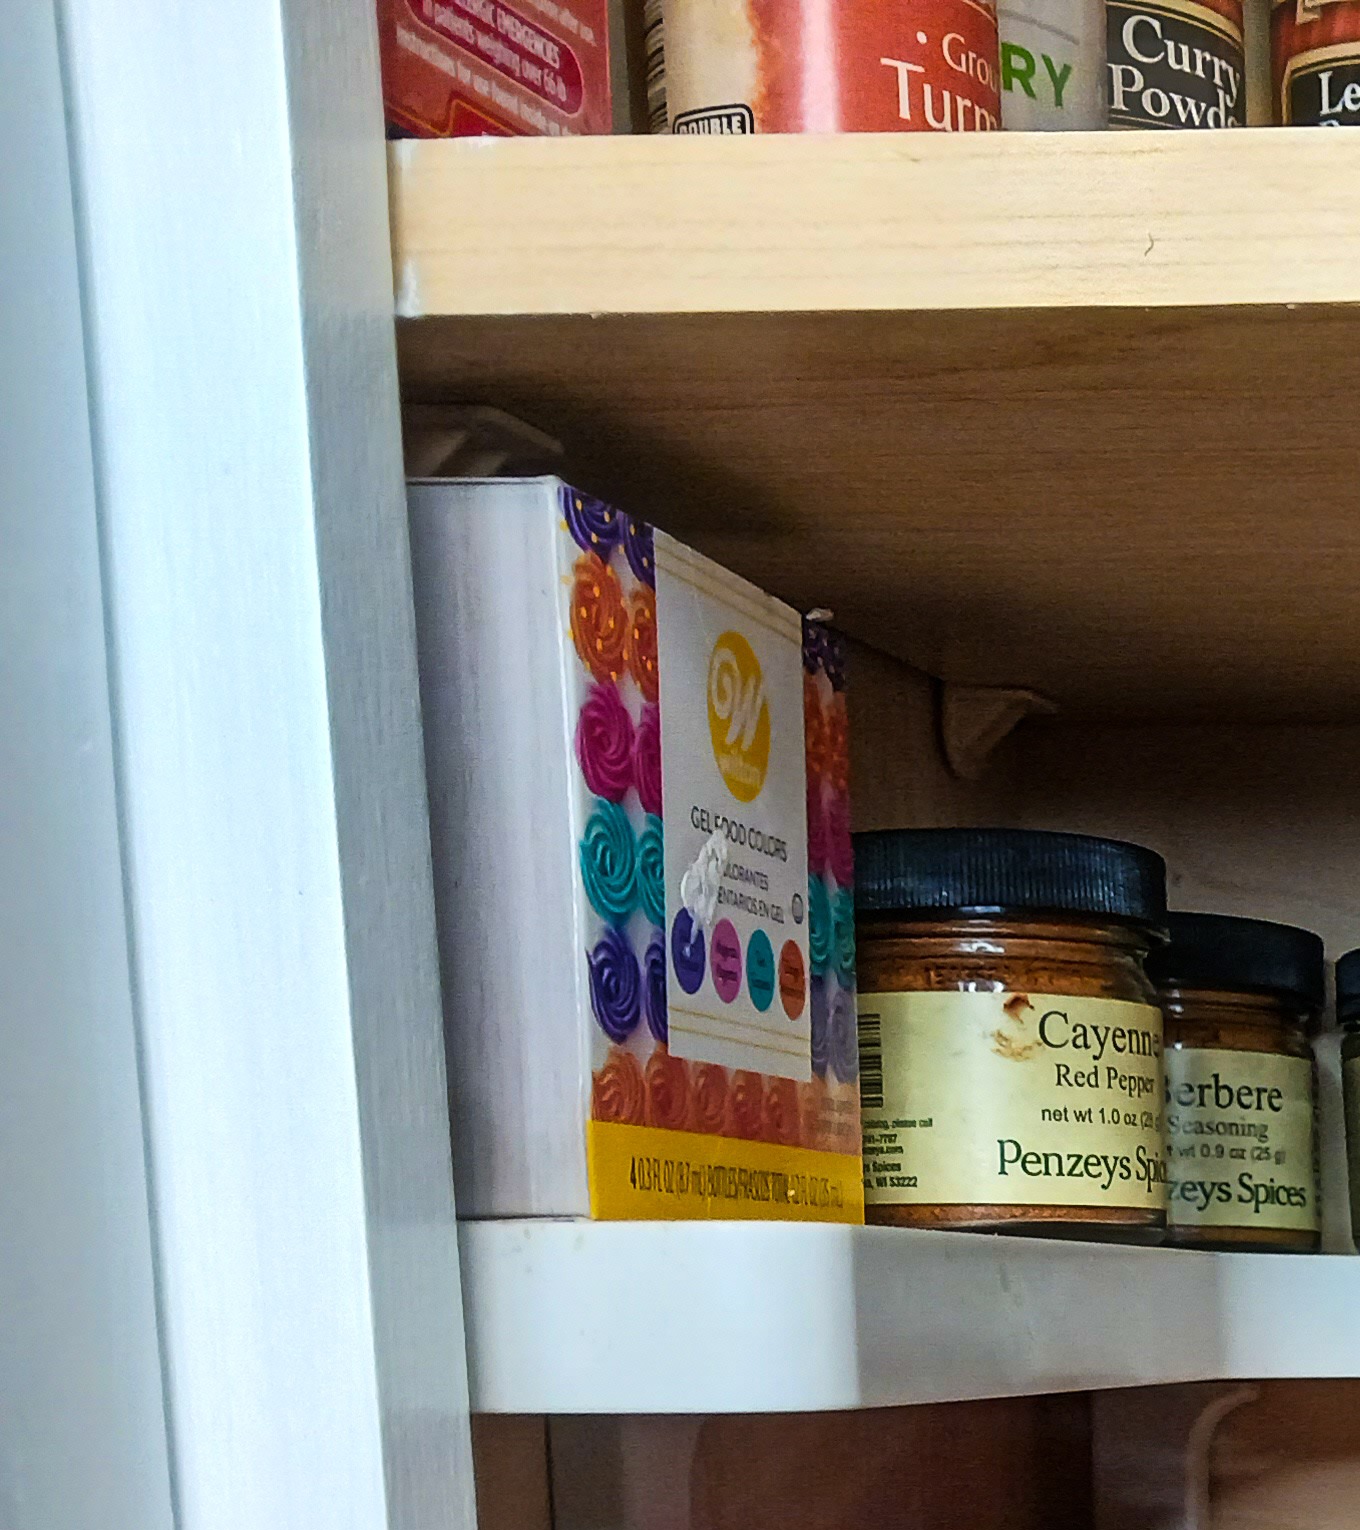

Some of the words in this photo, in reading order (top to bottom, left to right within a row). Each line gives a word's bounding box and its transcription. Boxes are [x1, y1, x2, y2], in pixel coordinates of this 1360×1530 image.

[1122, 14, 1241, 108] Curry
[690, 804, 713, 835] GEL
[1055, 1063, 1099, 1089] Red
[1106, 1066, 1155, 1098] Pepper
[1041, 1105, 1069, 1123] net
[1073, 1107, 1093, 1124] wt
[1099, 1107, 1121, 1125] 1.0
[1124, 1112, 1137, 1127] oz
[1167, 1114, 1269, 1143] Seasoning
[997, 1139, 1132, 1191] Penzeys
[1237, 1172, 1307, 1214] Spices
